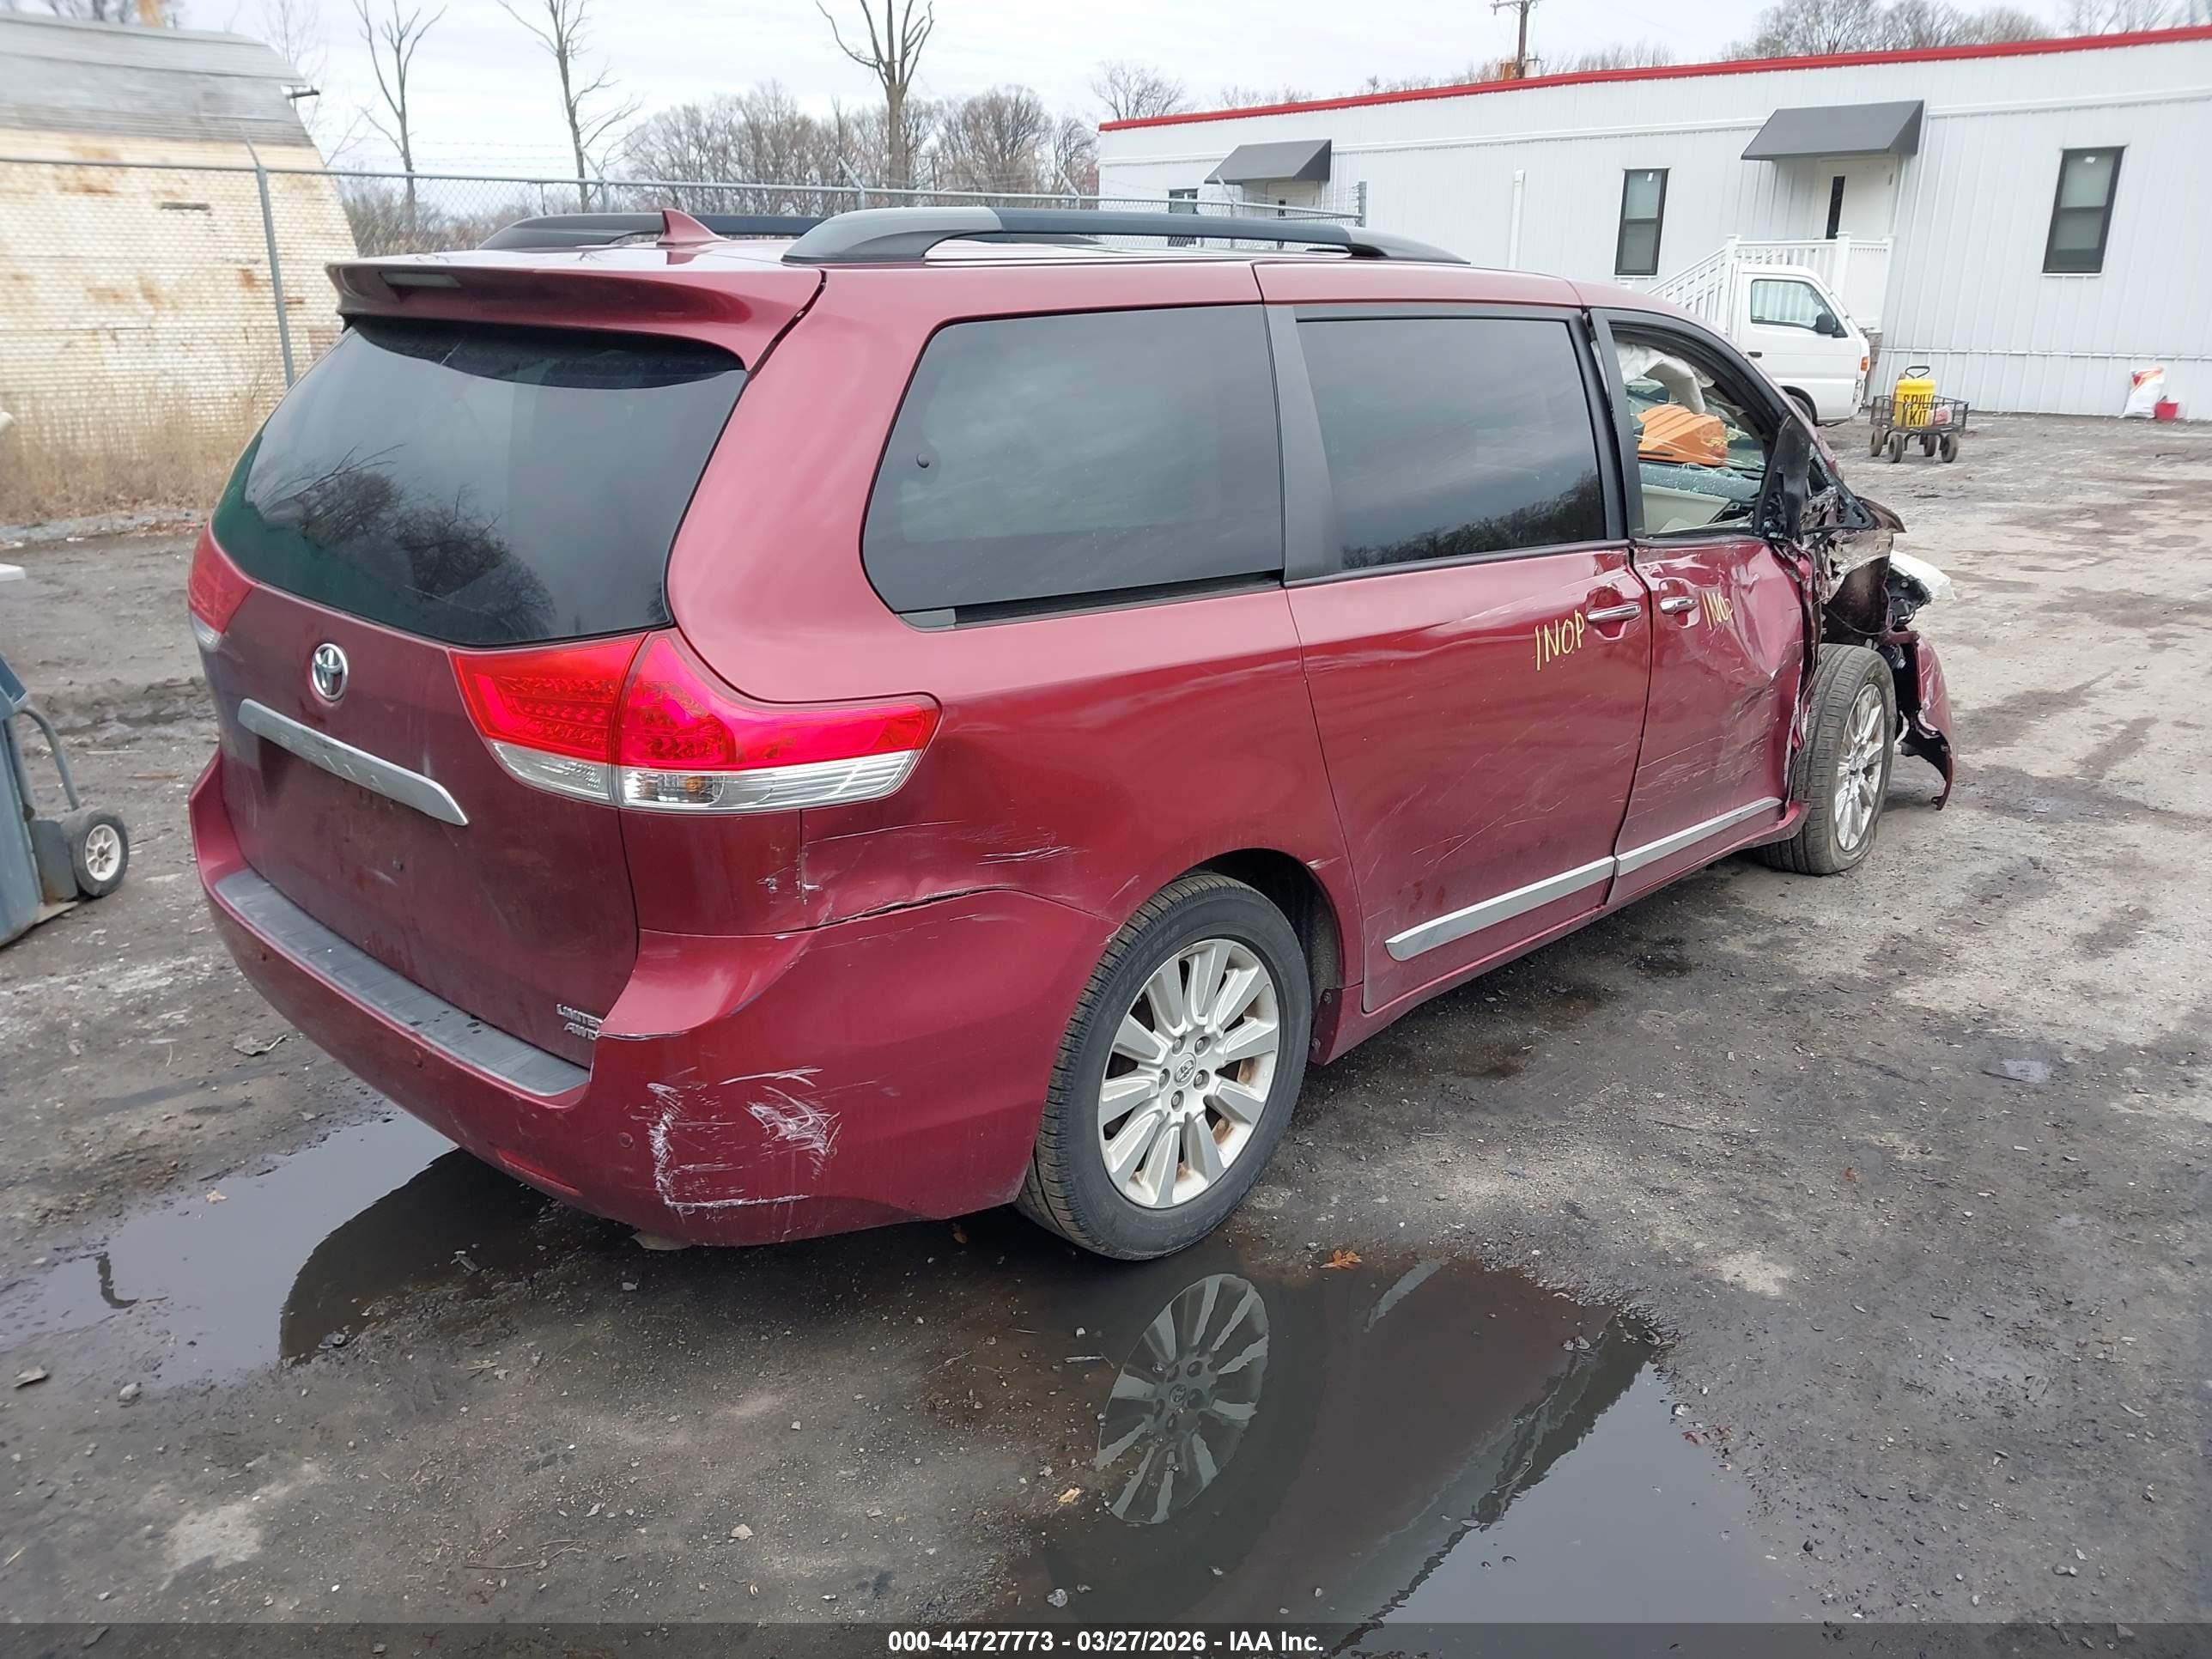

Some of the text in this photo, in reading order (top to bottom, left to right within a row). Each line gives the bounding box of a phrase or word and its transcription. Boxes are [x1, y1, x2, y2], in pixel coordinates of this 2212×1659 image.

[1908, 410, 1929, 426] KIT
[1534, 609, 1585, 672] INOP
[563, 1021, 600, 1041] AWD
